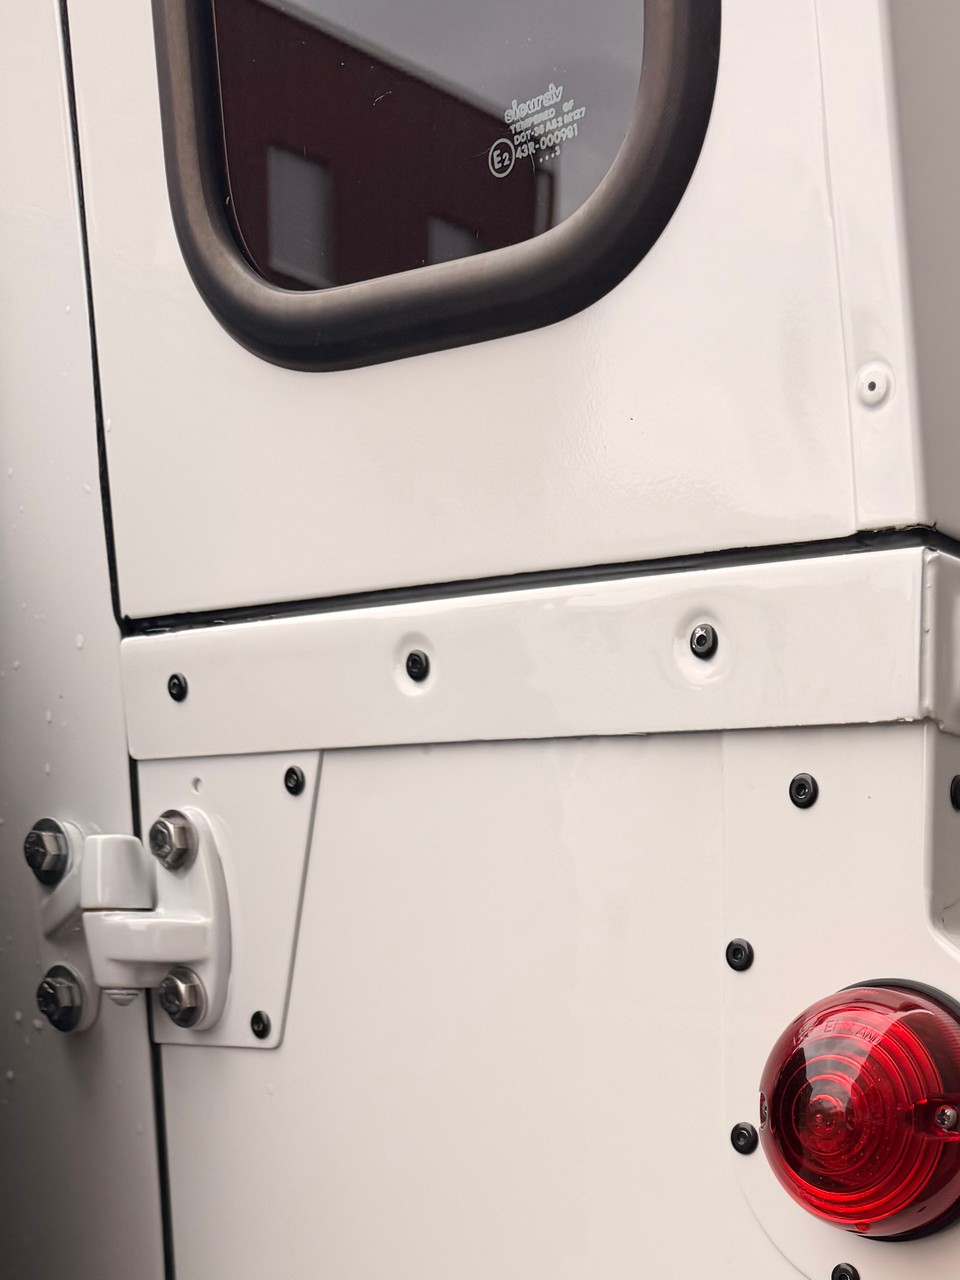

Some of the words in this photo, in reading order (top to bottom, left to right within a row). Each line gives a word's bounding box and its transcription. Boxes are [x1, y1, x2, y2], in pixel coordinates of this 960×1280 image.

[509, 108, 556, 135] TEMPERED
[493, 148, 511, 170] E2
[823, 1019, 882, 1045] EAND
